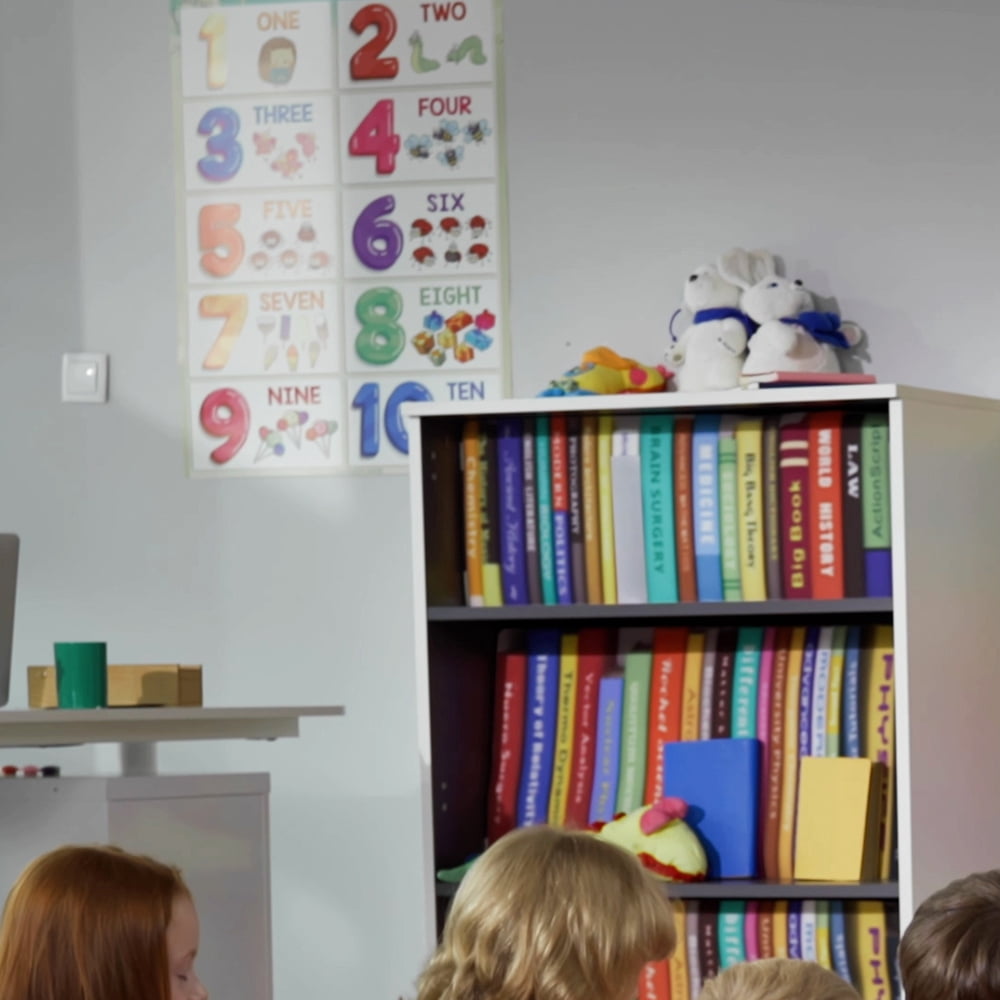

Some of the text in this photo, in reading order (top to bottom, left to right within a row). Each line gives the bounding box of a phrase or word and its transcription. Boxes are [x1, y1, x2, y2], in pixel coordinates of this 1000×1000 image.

[199, 1, 467, 89] 1 ONE 2 TWO
[197, 96, 471, 182] 3 THREE 4 FOUR
[199, 193, 465, 278] 5 FIVE 6 SIX
[198, 285, 481, 370] 7 SEVEN 8 EIGHT
[199, 387, 250, 465] 9
[267, 386, 321, 406] NINE
[447, 381, 485, 400] TEN
[465, 456, 479, 559] Chemistry
[569, 436, 580, 535] PHOTOGRAPHY
[649, 425, 665, 575] BRAIN SURGERY
[698, 444, 715, 545] MEDICINE
[818, 428, 835, 577] WORLD HISTORY
[846, 444, 860, 499] LAW
[554, 514, 567, 596] POLITICS
[788, 480, 807, 589] Big Book
[533, 654, 548, 716] Theory
[582, 672, 594, 728] Vector
[534, 720, 547, 739] of
[769, 748, 782, 820] Physics
